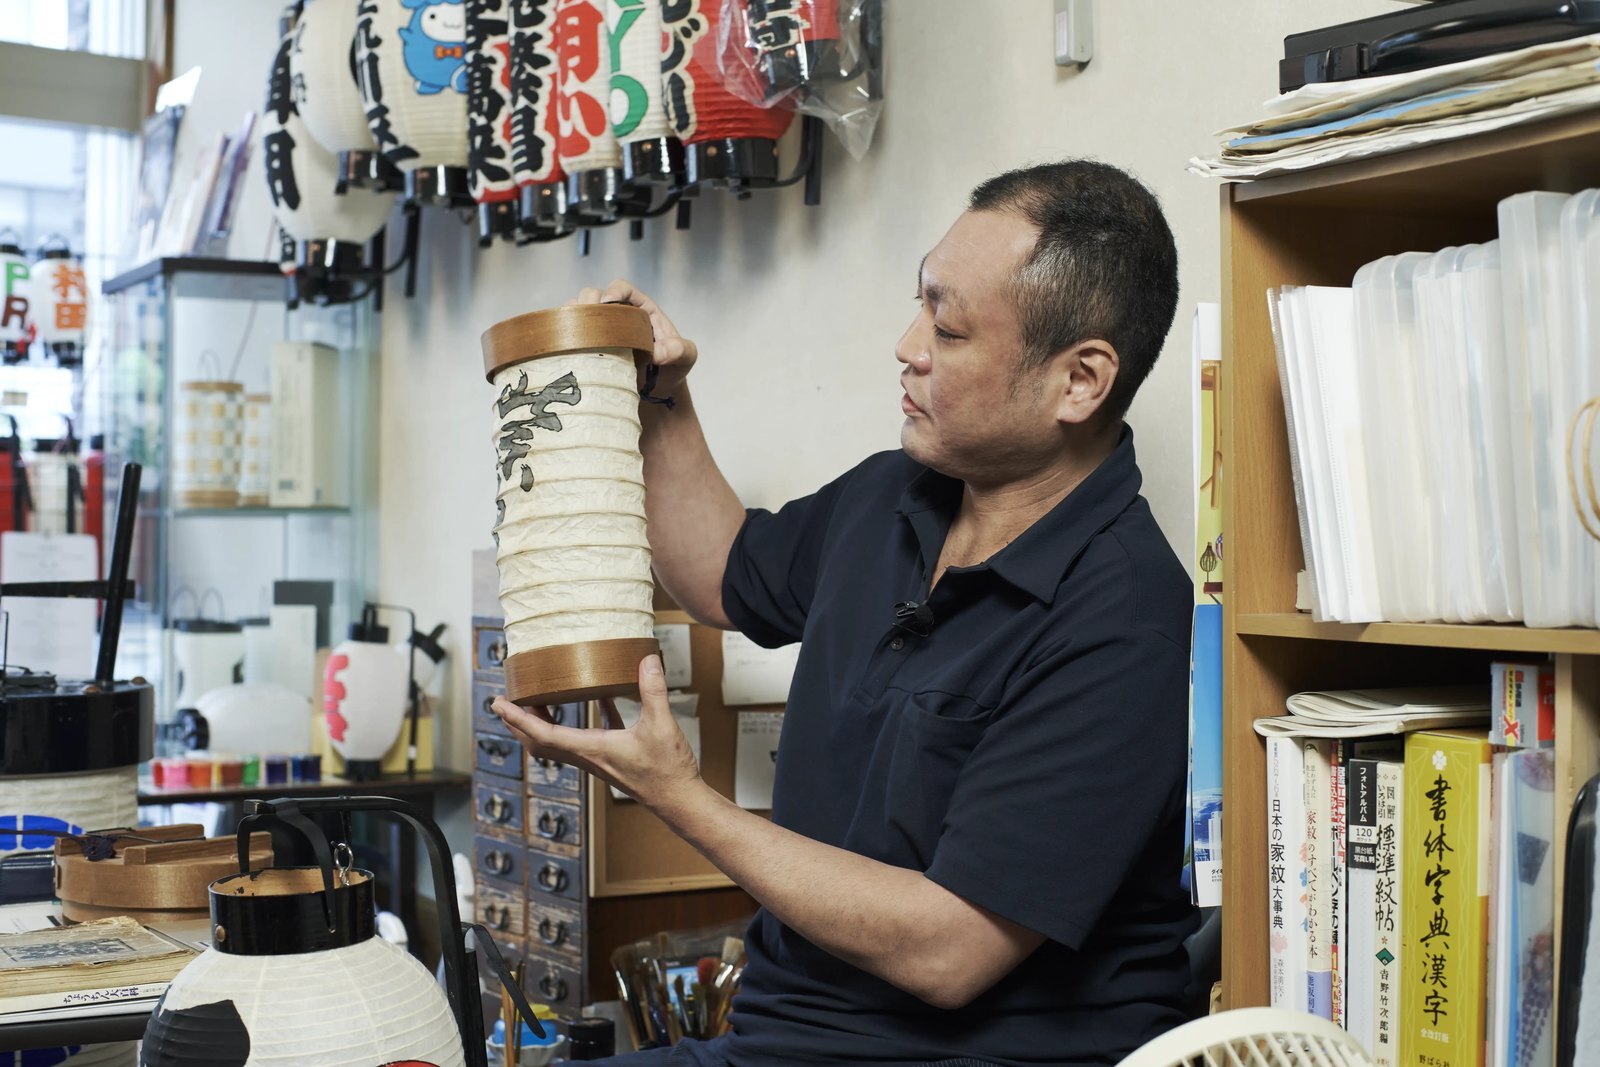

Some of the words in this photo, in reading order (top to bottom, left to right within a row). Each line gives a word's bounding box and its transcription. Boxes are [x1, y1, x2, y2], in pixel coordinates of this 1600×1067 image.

[606, 0, 649, 138] YO
[1359, 767, 1367, 822] フォトアルバム
[1378, 784, 1386, 818] いろは引
[1353, 854, 1375, 863] 写真L判
[1355, 828, 1373, 838] 120
[1270, 799, 1286, 929] 日本の家紋大事典
[1306, 810, 1318, 959] 家紋のすべてがわかる本
[1375, 823, 1398, 932] 標準紋帖
[1420, 774, 1454, 1026] 書体字典漢字
[63, 986, 139, 1004] ちょうちん大百科
[1420, 1027, 1449, 1043] 全改訂版
